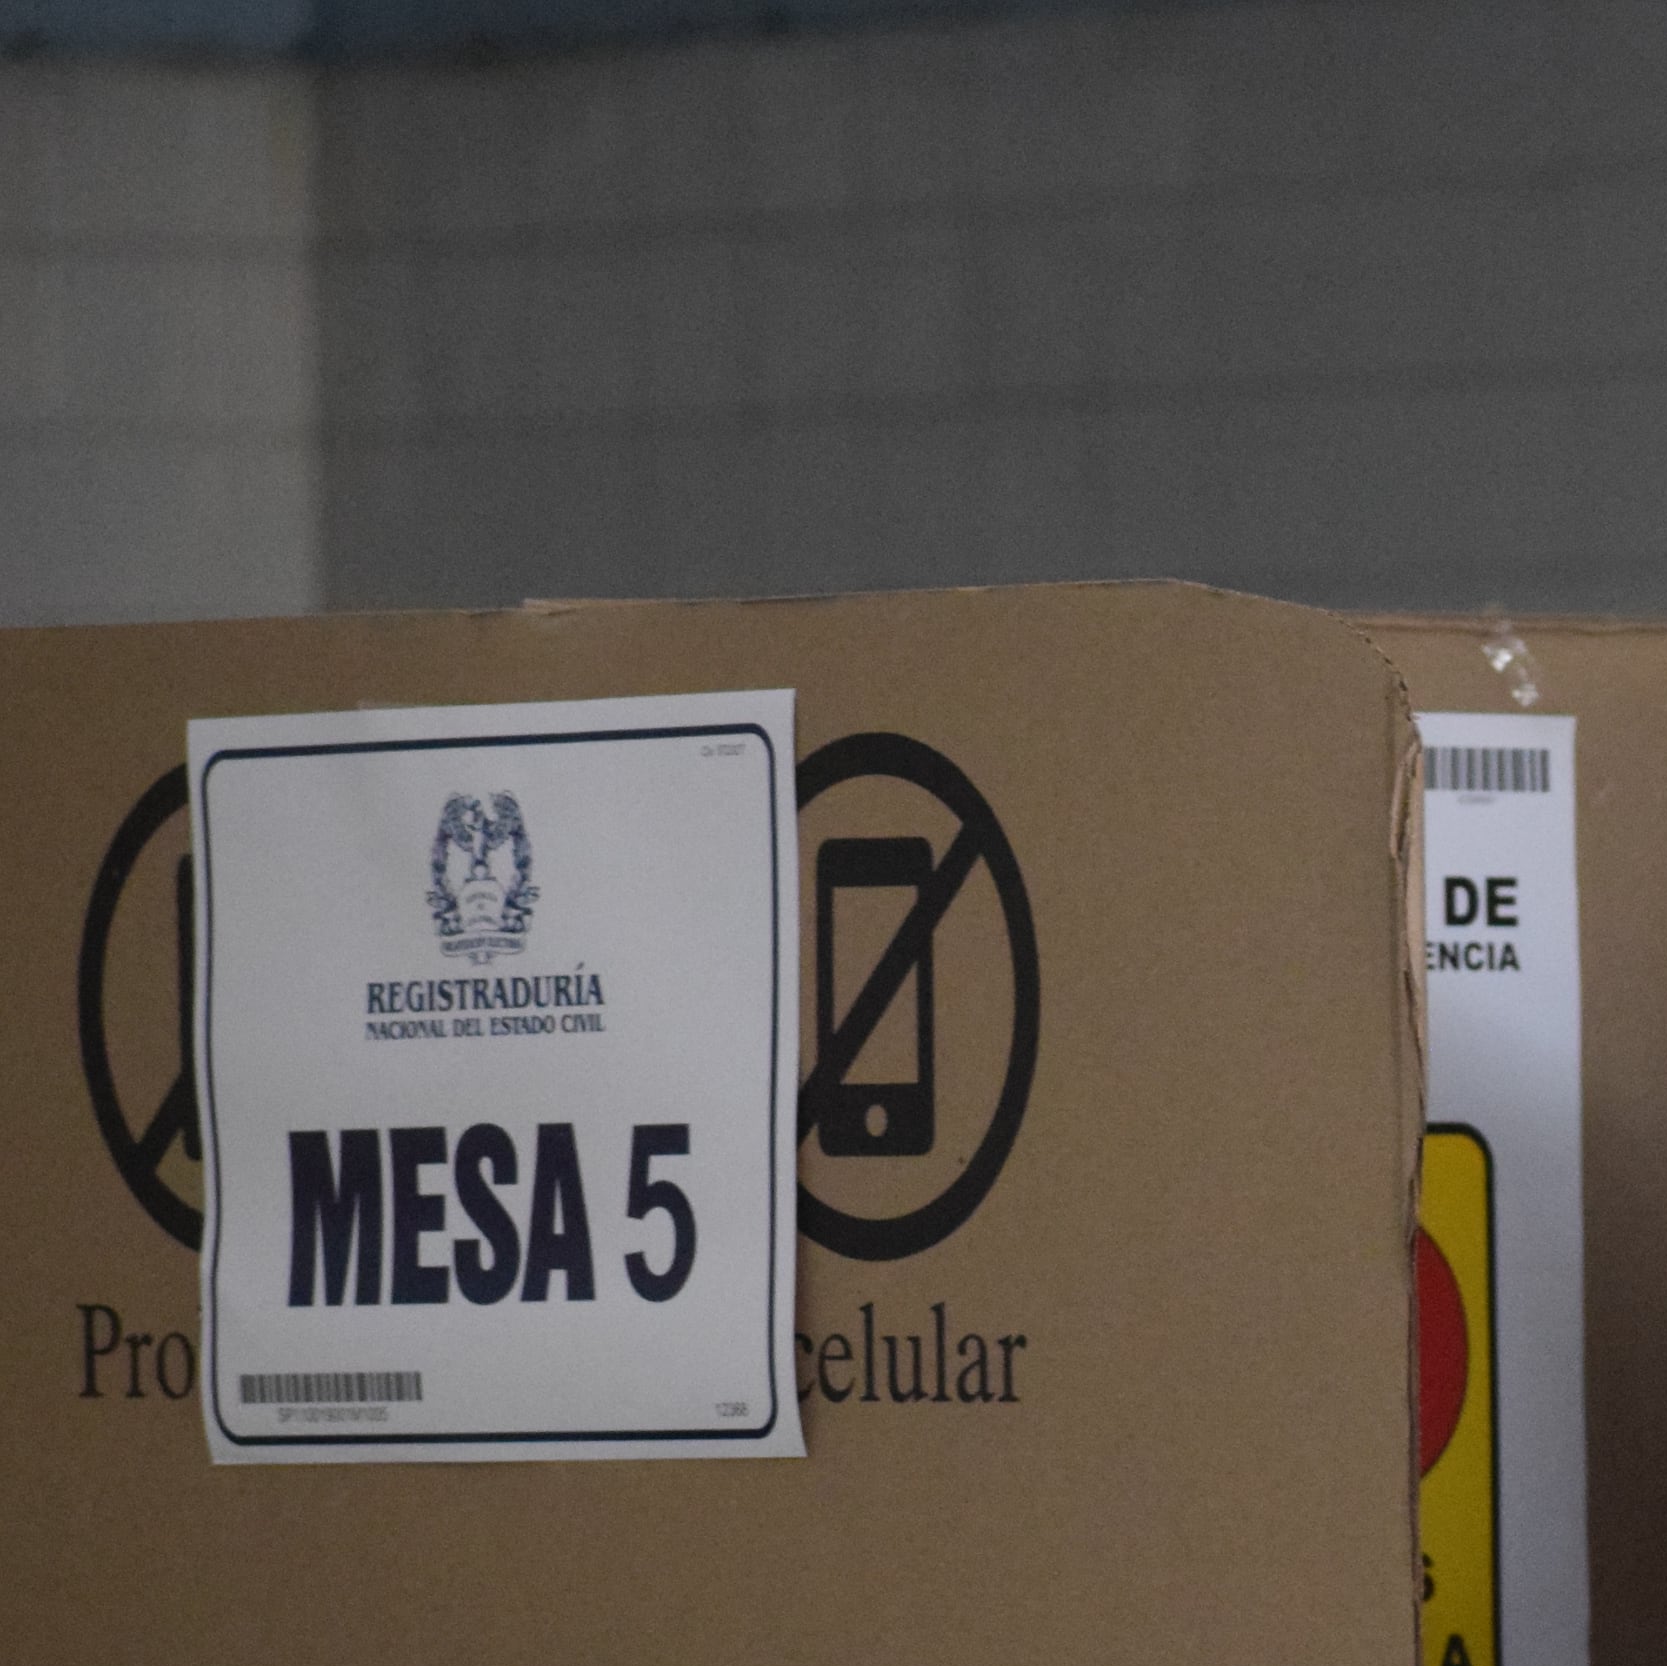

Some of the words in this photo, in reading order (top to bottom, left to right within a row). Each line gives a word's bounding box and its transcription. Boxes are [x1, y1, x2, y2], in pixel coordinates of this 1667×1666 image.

[1444, 876, 1518, 927] DE
[367, 962, 604, 1014] REGISTRADURÍA
[365, 1019, 446, 1040] NACIONAL
[453, 1017, 484, 1037] DEL
[490, 1014, 555, 1036] ESTADO
[561, 1013, 606, 1033] CIVIL
[288, 1122, 596, 1307] MESA
[623, 1123, 696, 1303] 5
